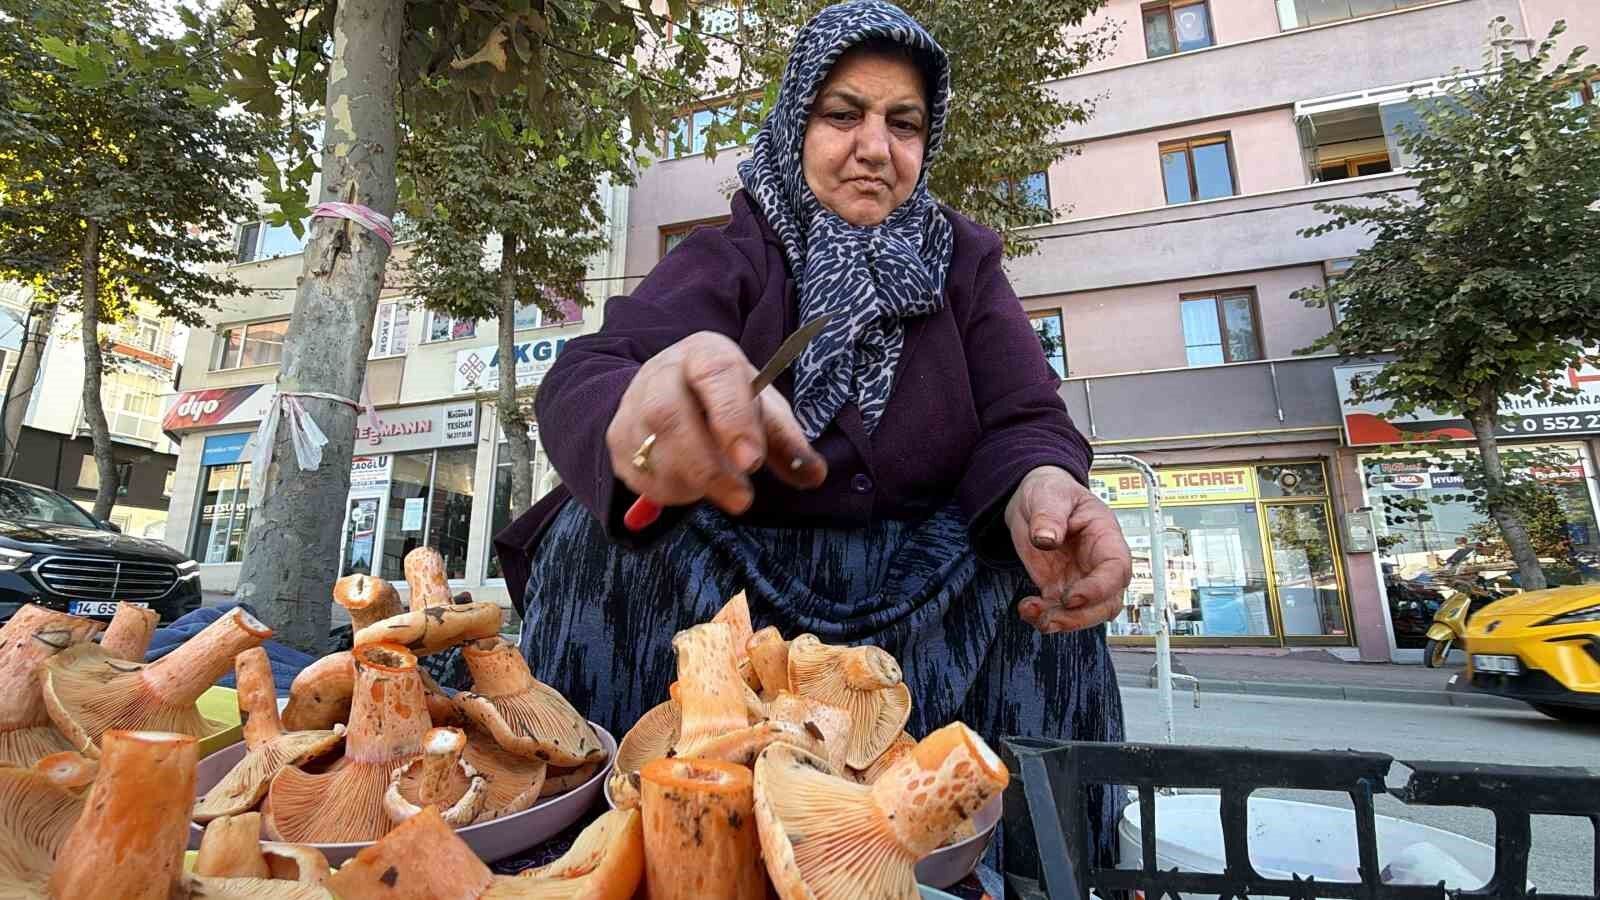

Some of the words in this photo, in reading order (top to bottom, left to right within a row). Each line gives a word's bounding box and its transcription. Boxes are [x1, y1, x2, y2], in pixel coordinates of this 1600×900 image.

[177, 396, 219, 421] dyo
[1523, 418, 1537, 431] 0
[1542, 416, 1582, 430] 552
[79, 603, 91, 614] 14
[98, 603, 117, 614] GS
